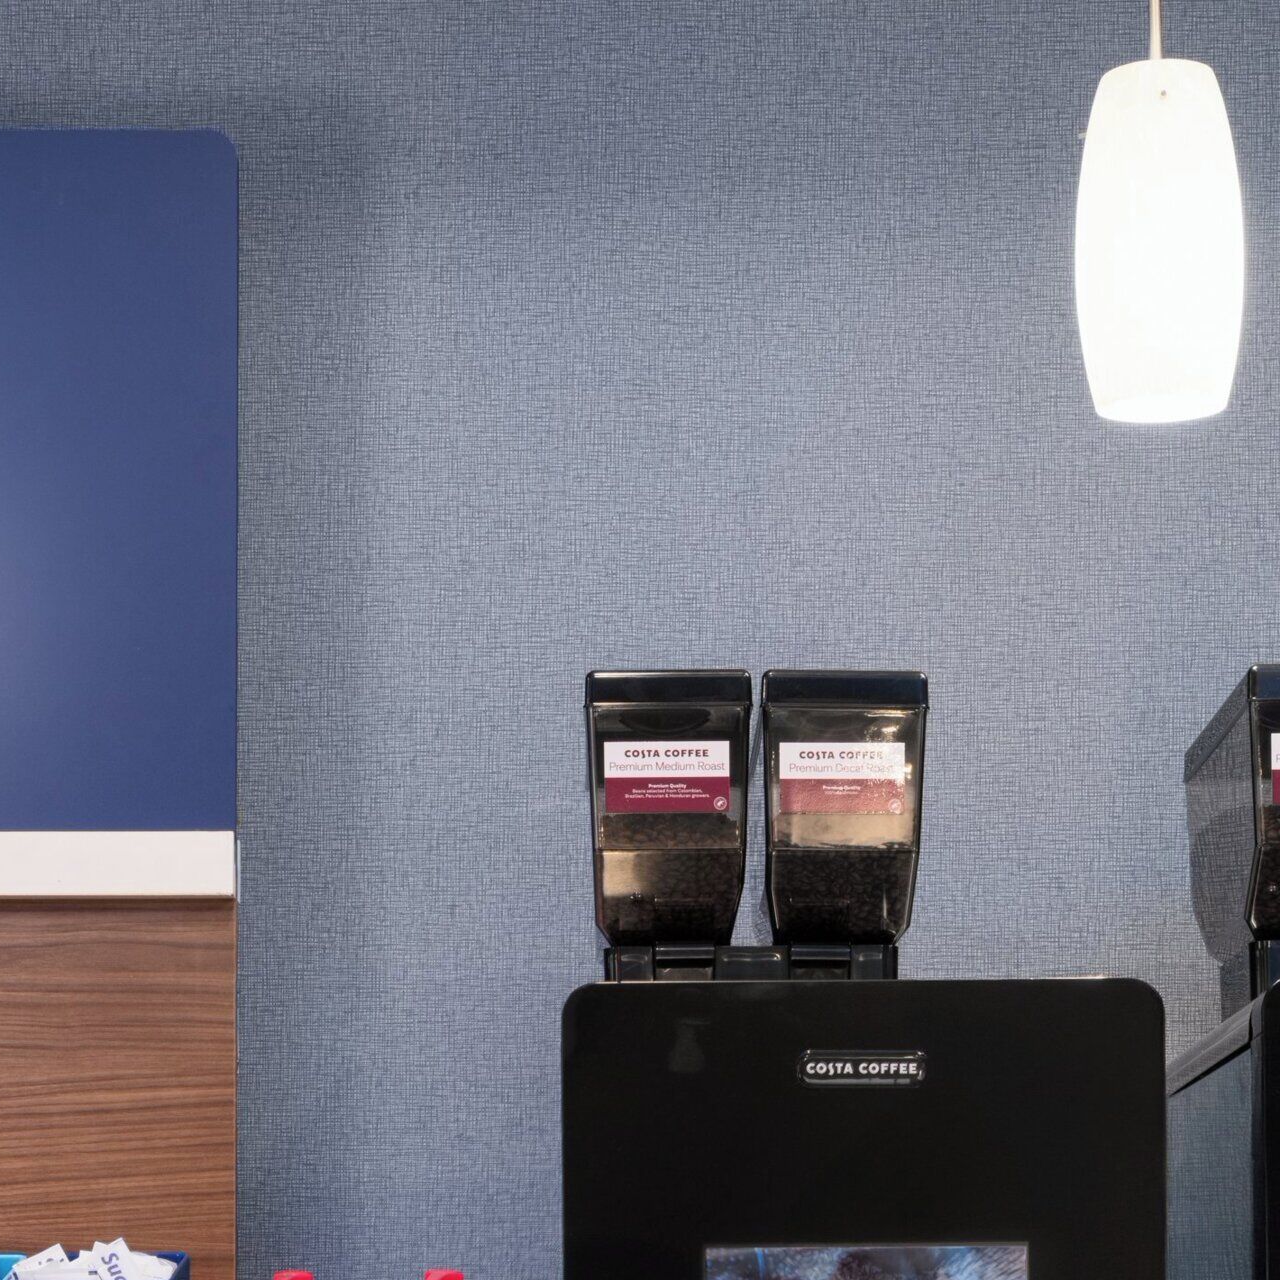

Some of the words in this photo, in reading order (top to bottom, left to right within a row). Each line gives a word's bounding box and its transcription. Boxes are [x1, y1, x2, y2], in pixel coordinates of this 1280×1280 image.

[624, 750, 660, 759] COSTA
[664, 749, 709, 757] COFFEE
[799, 751, 835, 760] COSTA
[839, 751, 884, 759] COFFEE
[609, 762, 653, 771] Premium
[656, 761, 695, 771] Medium
[697, 761, 725, 771] Roast
[789, 763, 832, 772] Premium
[806, 1062, 854, 1076] COSTA
[858, 1062, 918, 1075] COFFEE
